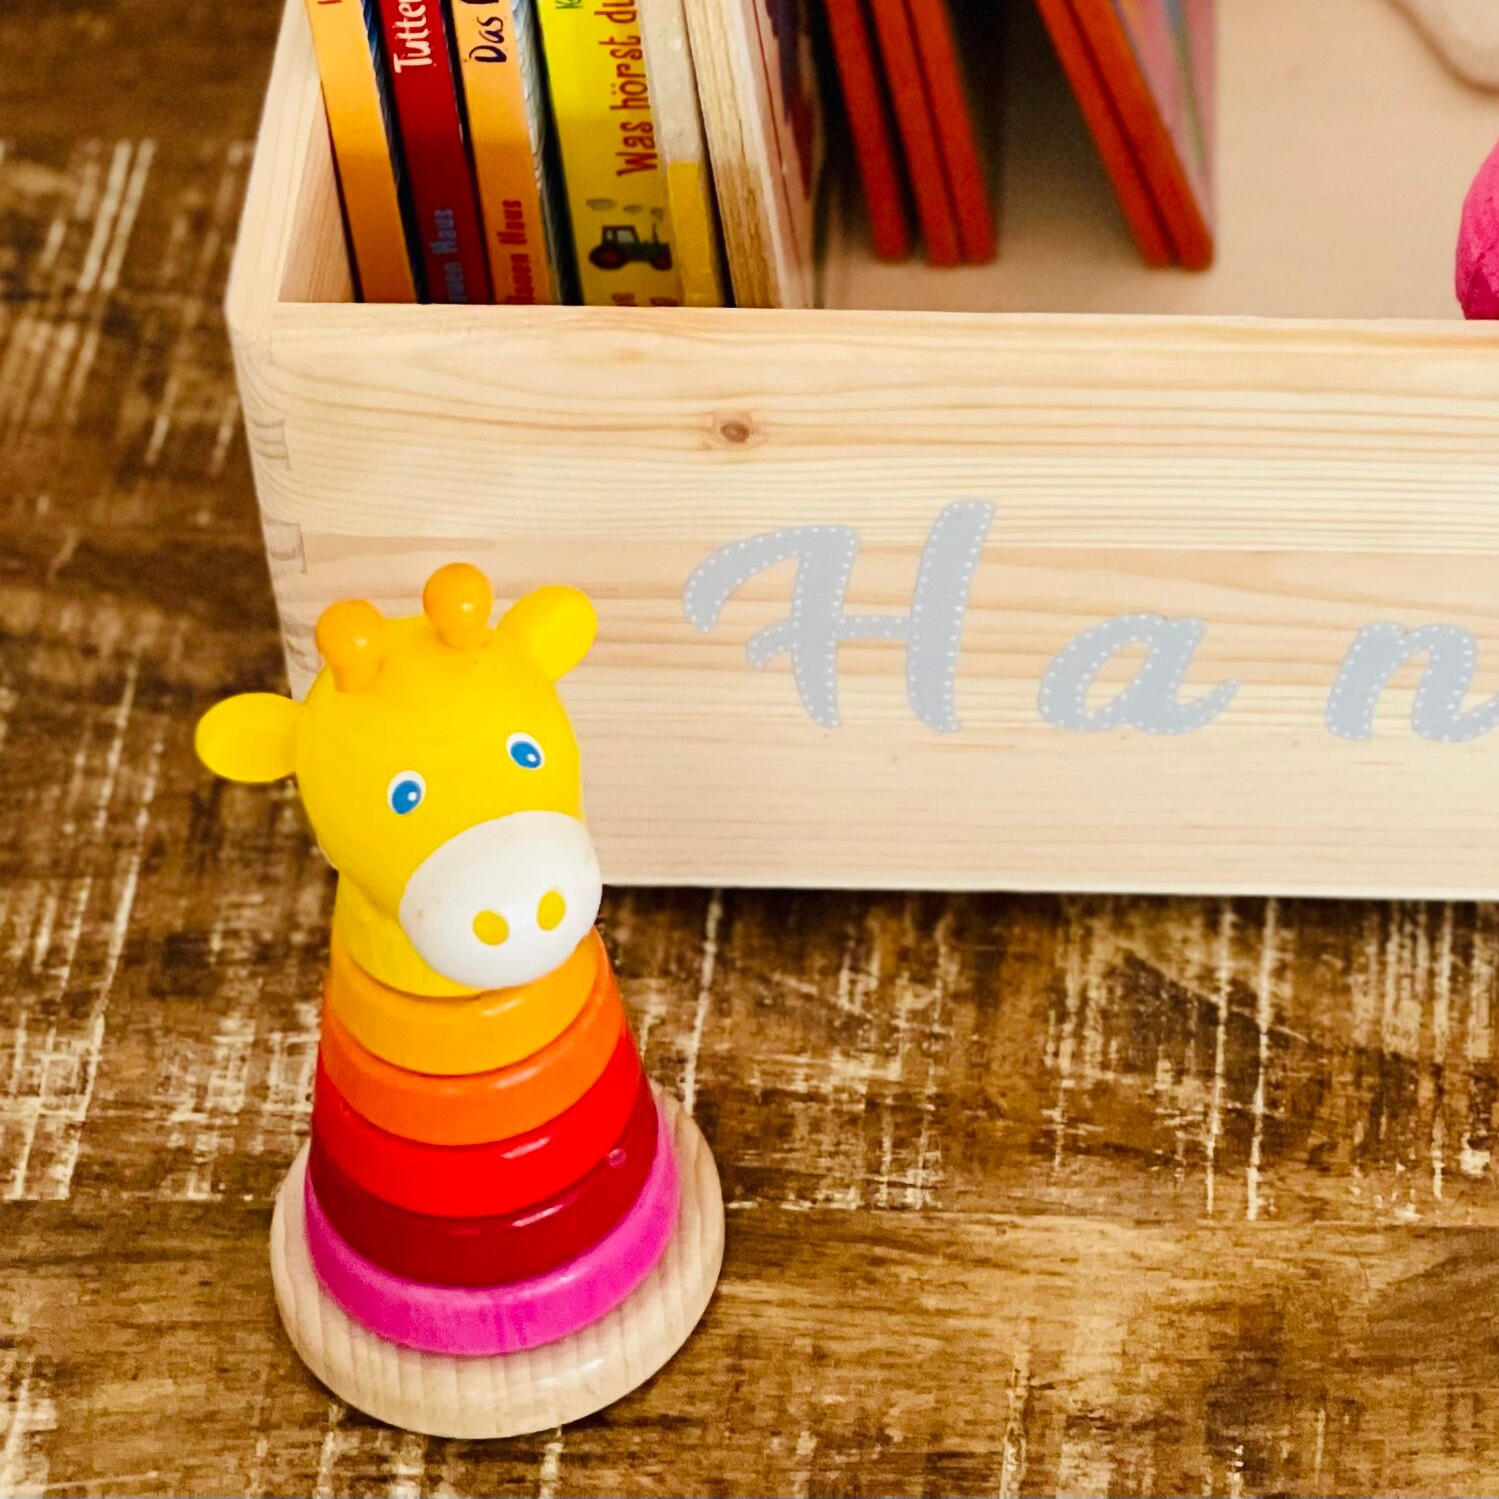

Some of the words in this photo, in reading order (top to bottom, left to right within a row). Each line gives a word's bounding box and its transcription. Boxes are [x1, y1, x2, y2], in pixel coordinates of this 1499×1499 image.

[468, 16, 507, 63] Das
[599, 34, 651, 112] hörst
[616, 120, 658, 177] Was
[496, 200, 527, 245] Haus
[505, 254, 535, 305] lauen
